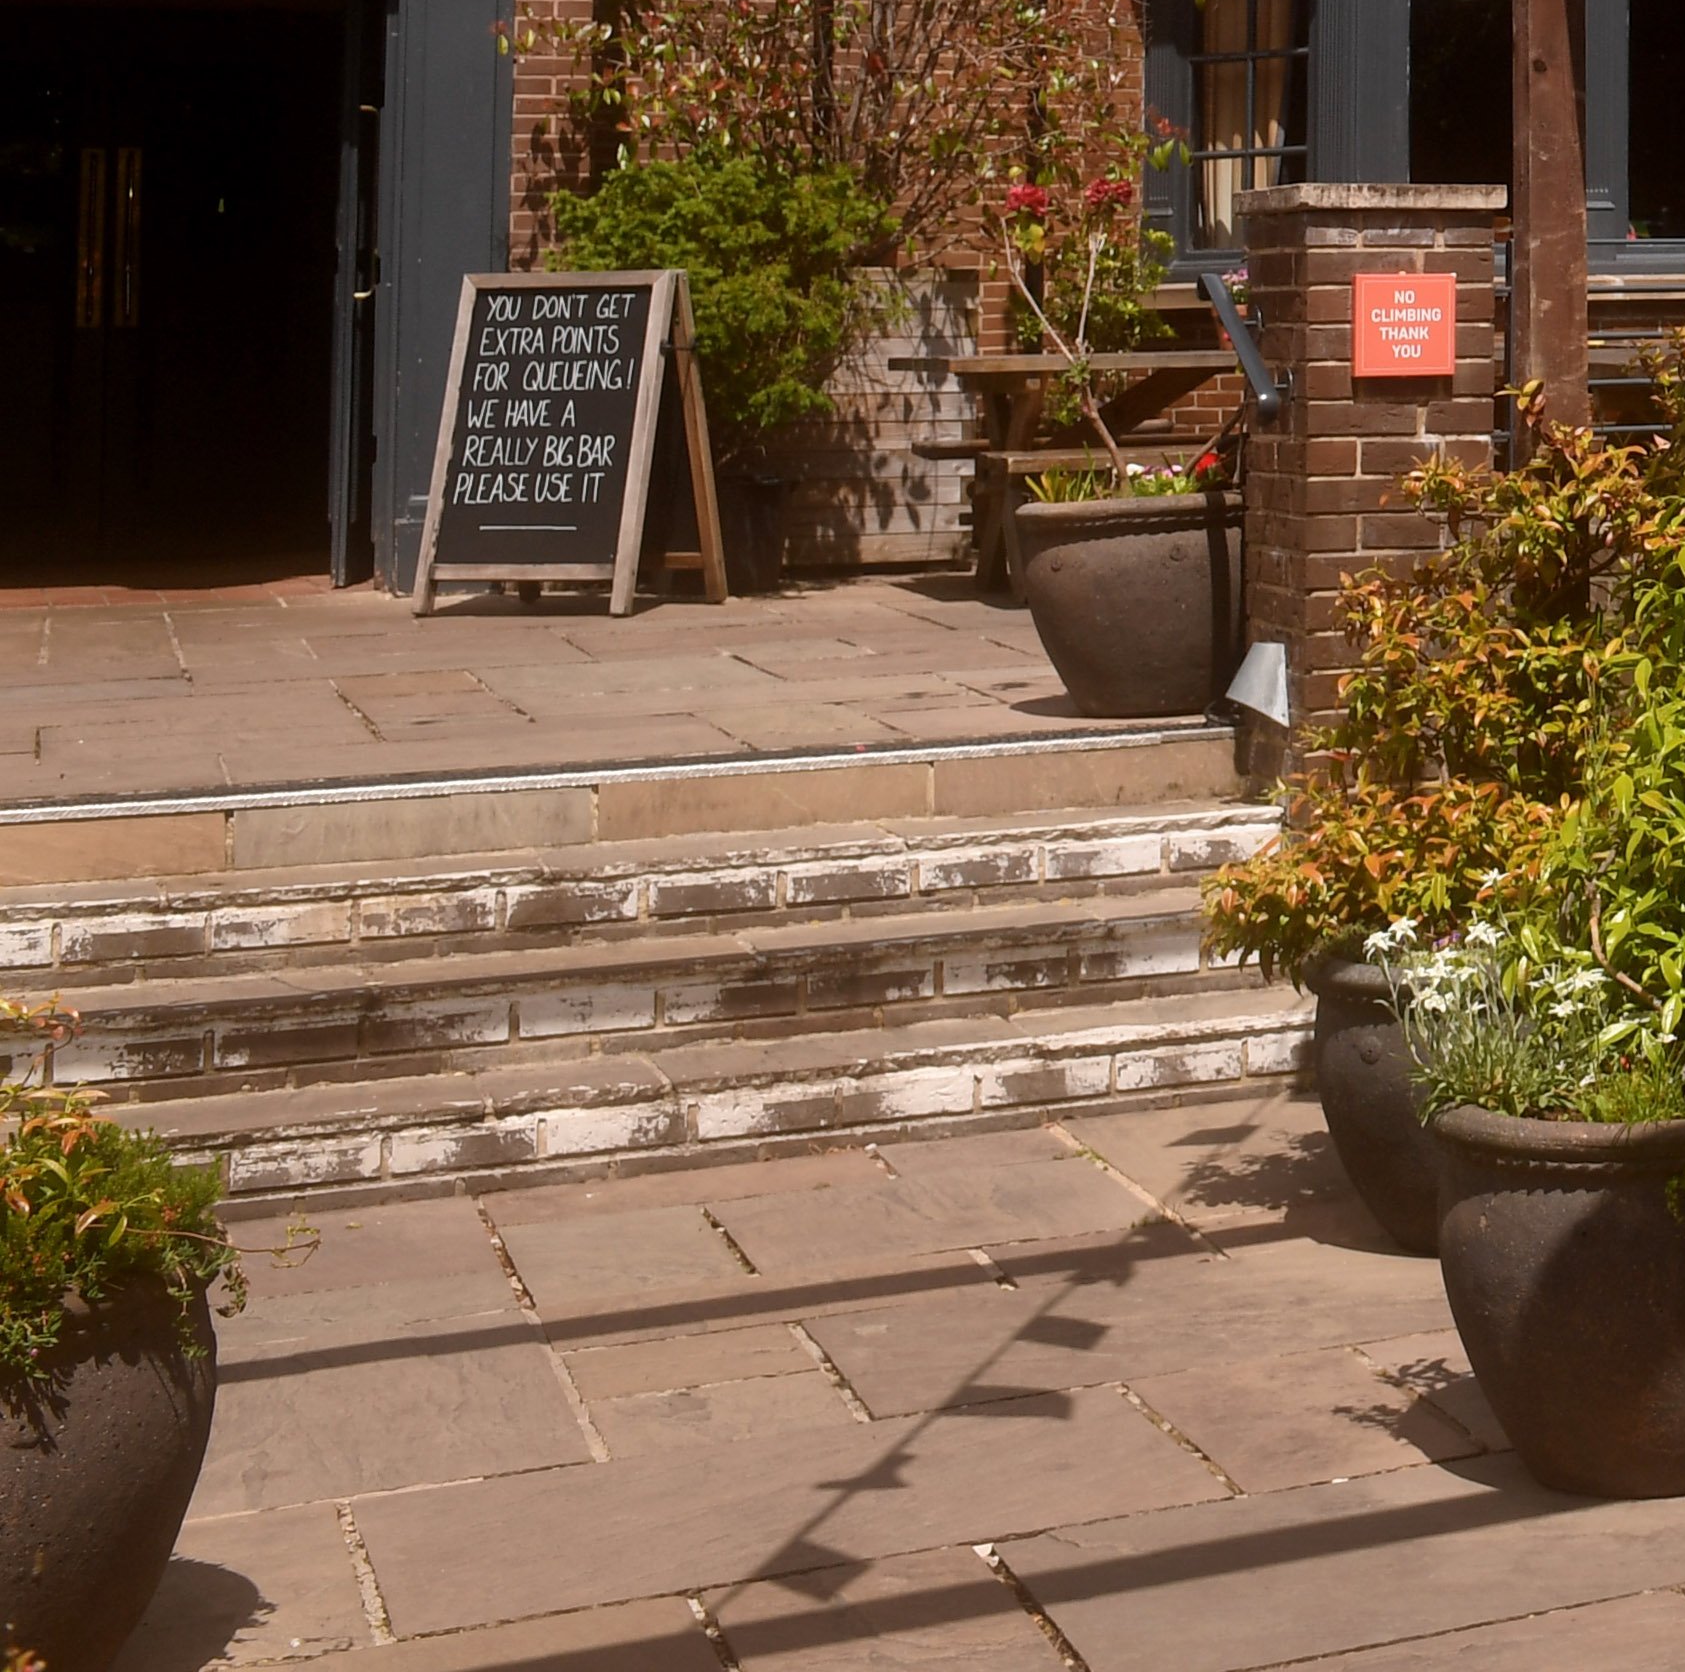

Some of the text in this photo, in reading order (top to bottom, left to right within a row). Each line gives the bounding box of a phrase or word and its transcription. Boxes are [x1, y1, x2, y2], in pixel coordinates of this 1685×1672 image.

[486, 293, 636, 321] YOU DON'T GET
[1394, 290, 1415, 304] NO
[1371, 308, 1442, 323] CLIMBING
[480, 325, 620, 357] EXTRA POINTS
[1379, 326, 1429, 340] THANK
[1392, 344, 1422, 359] YOU
[473, 361, 510, 392] FOR
[467, 399, 576, 429] WE HAVE A
[462, 434, 616, 468] REALLY BIG BAR
[452, 472, 606, 505] PLEASE USE IT
